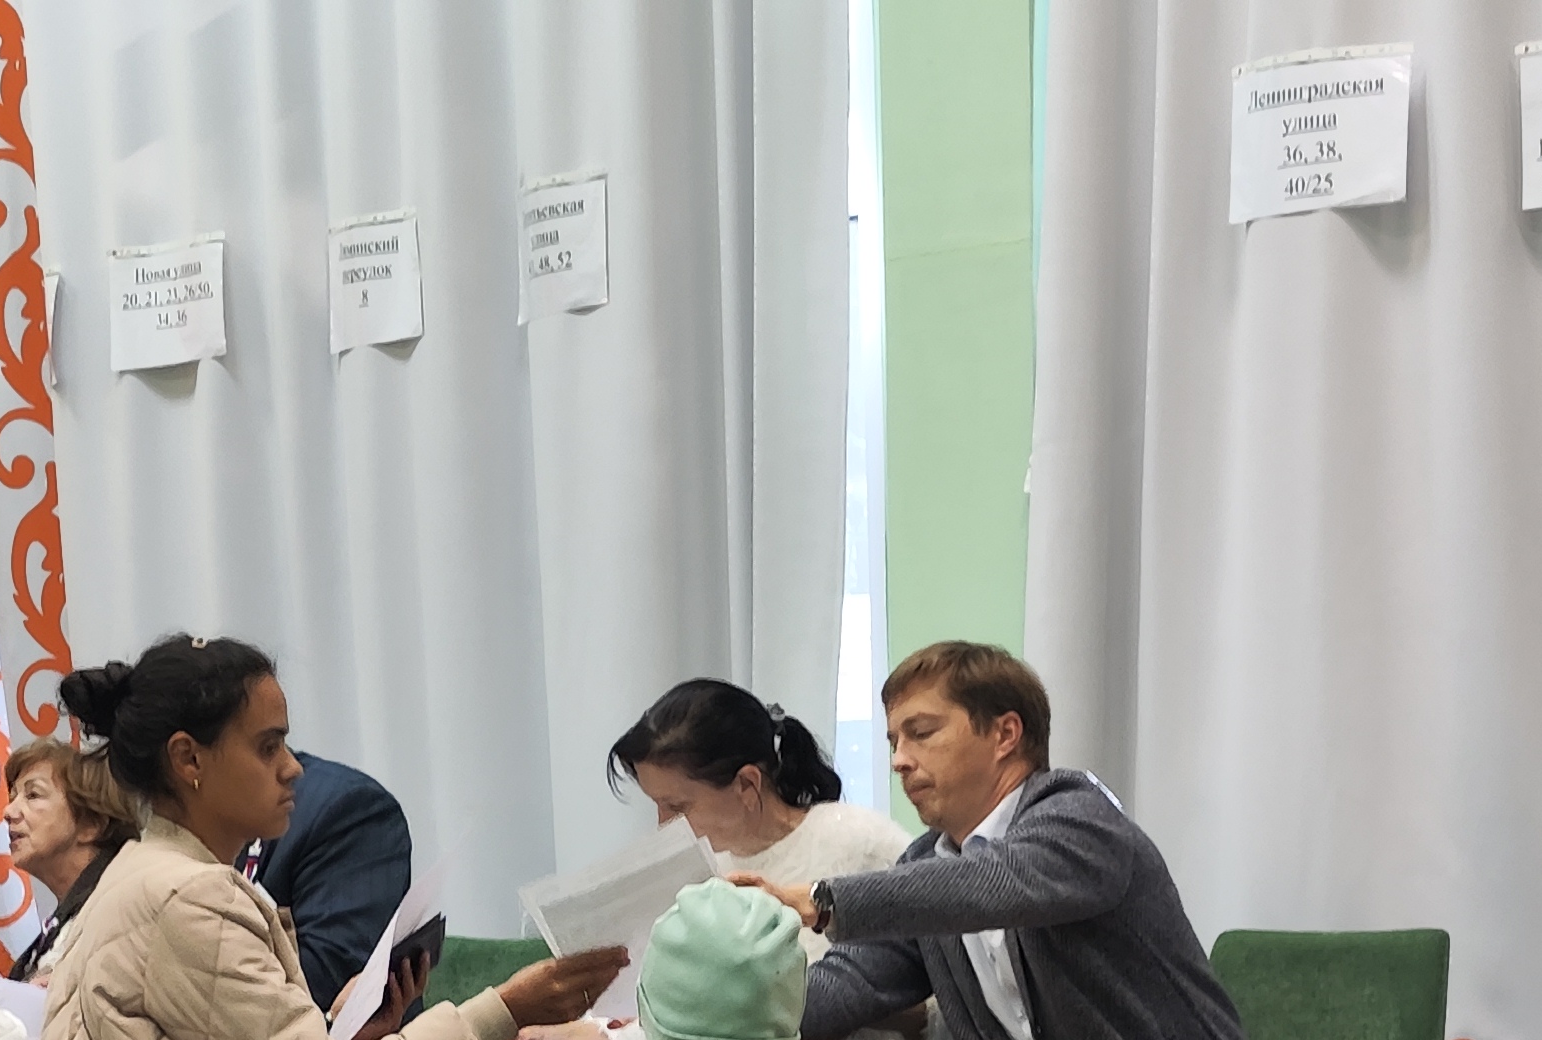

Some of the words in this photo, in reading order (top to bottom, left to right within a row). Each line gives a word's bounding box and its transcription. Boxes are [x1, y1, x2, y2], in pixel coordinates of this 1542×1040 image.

[1248, 78, 1384, 112] Ленинградская
[1282, 113, 1337, 137] улица
[1283, 144, 1308, 165] 36,
[1315, 140, 1342, 162] 38,
[1284, 172, 1334, 196] 40/25
